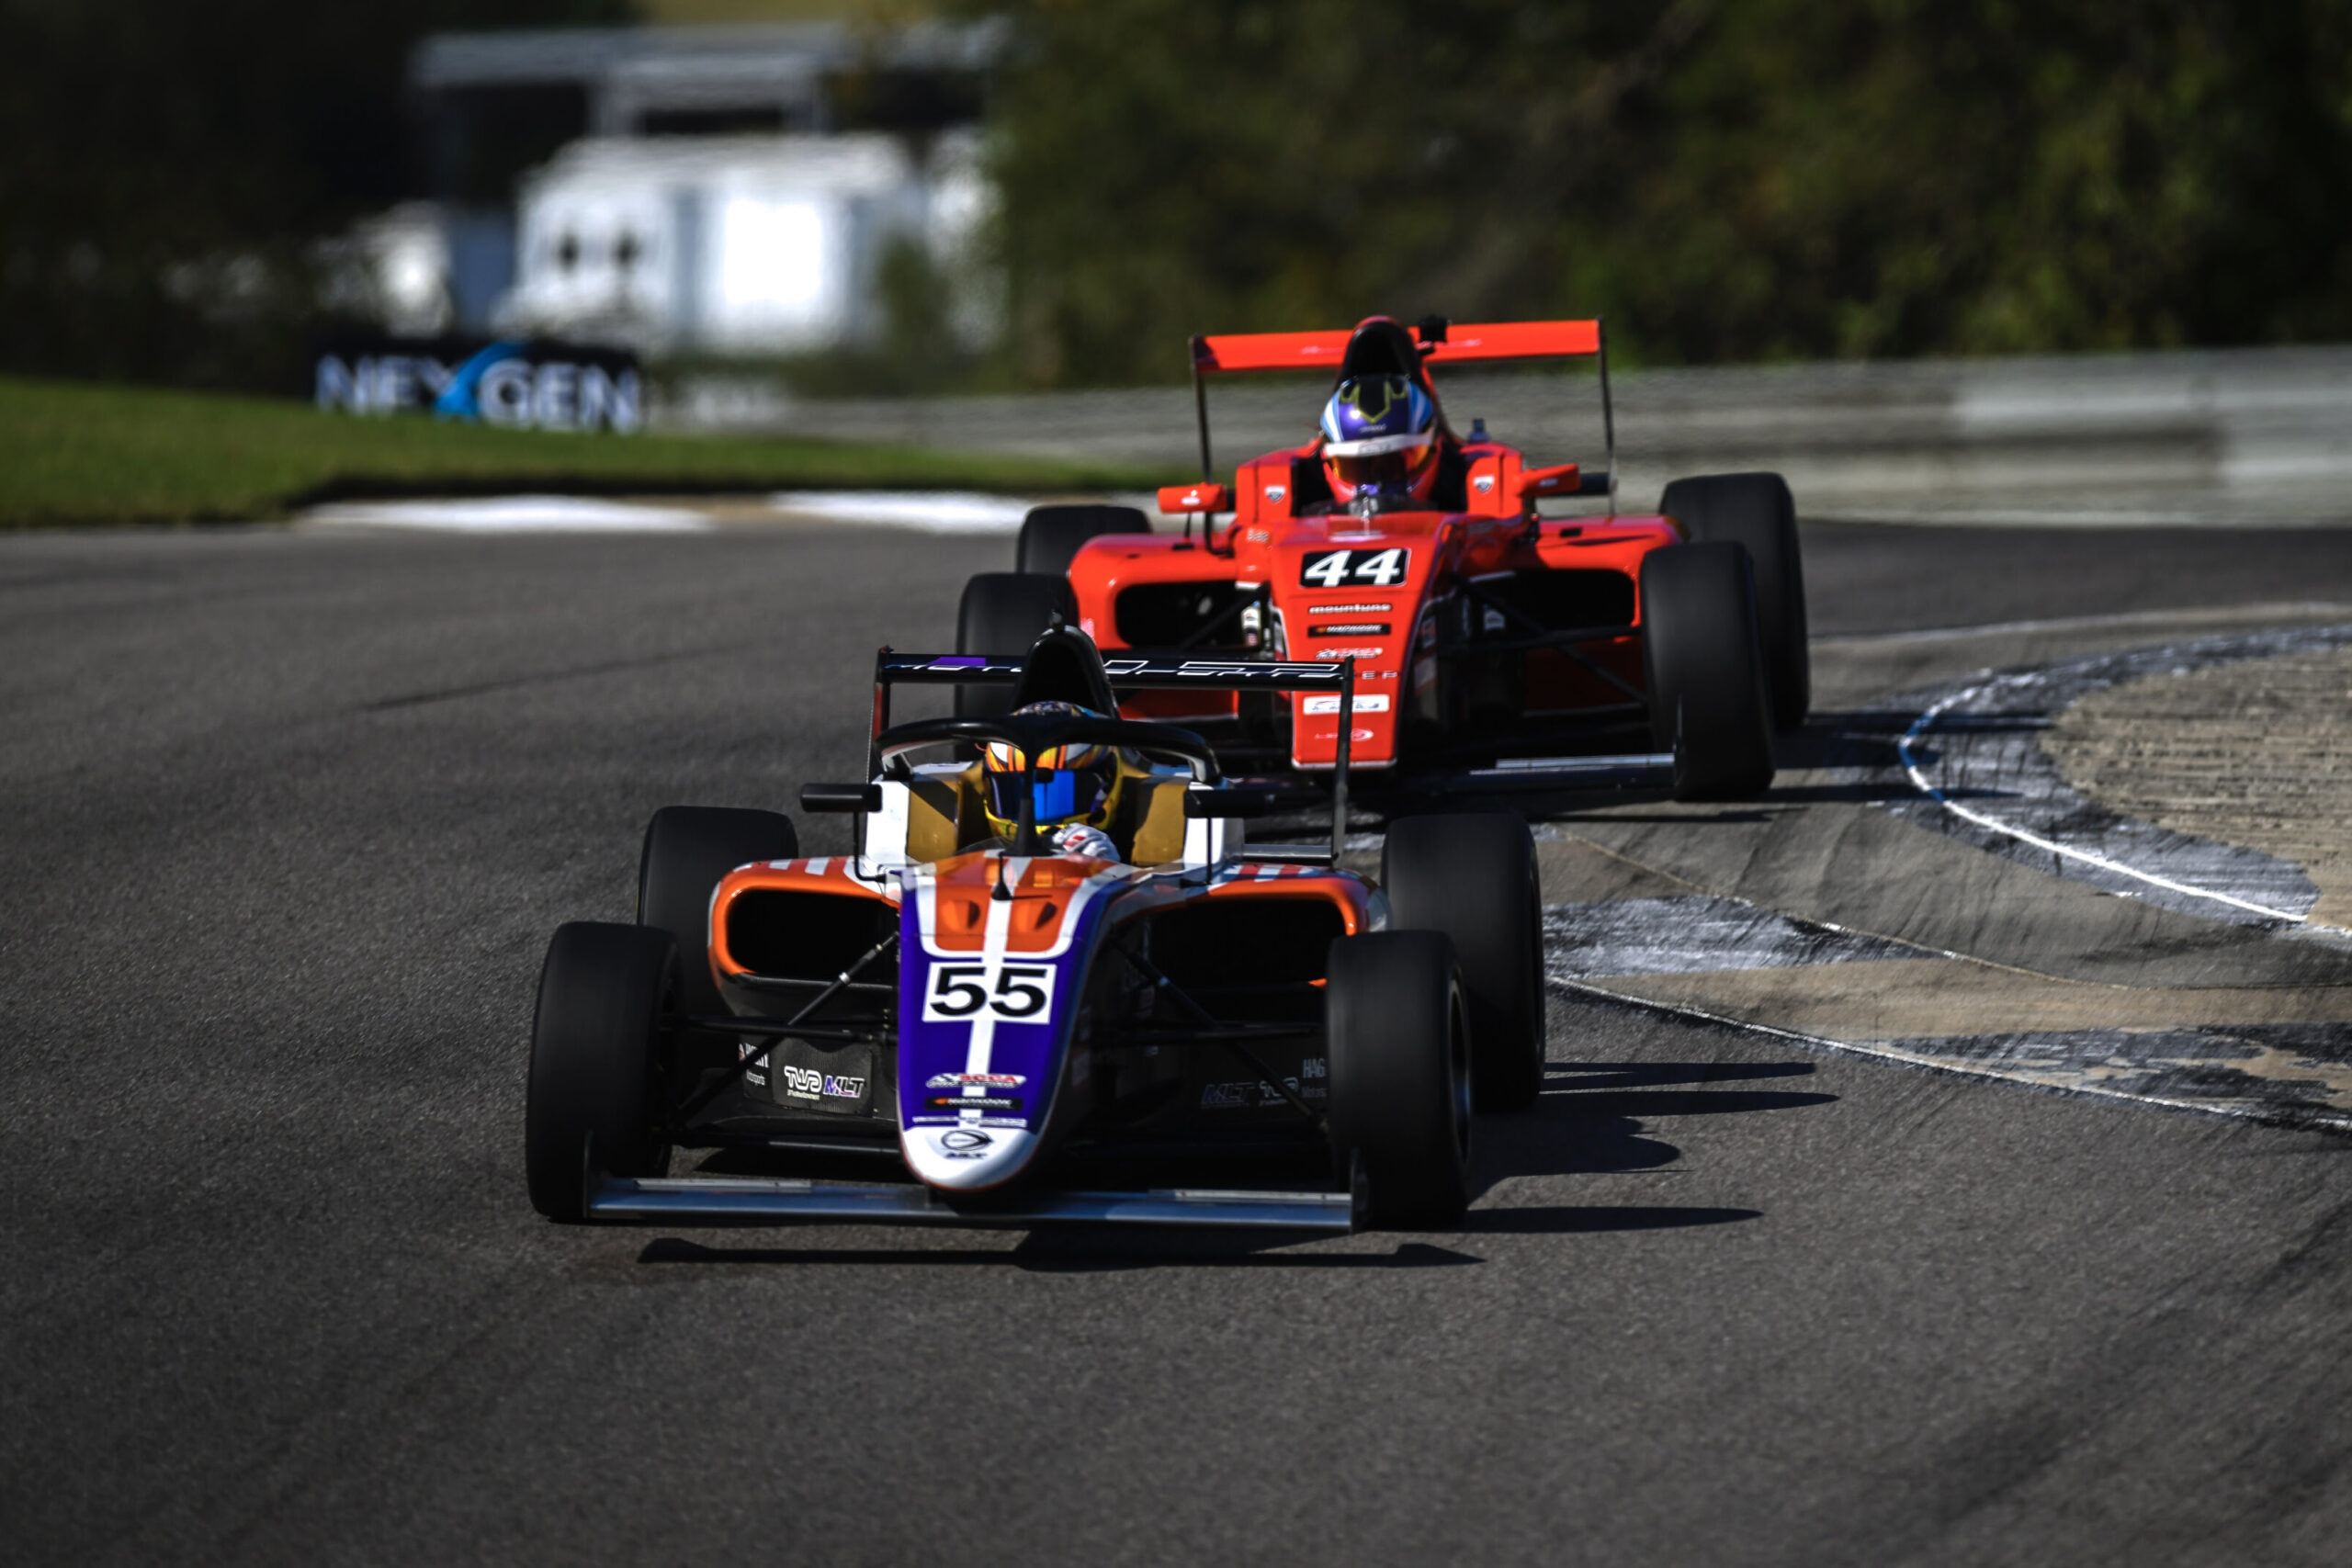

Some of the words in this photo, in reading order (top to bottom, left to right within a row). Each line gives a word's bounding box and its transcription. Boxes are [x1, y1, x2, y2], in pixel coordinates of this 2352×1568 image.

[1305, 548, 1401, 587] 44
[930, 966, 1047, 1017] 55
[822, 1075, 865, 1099] MLT
